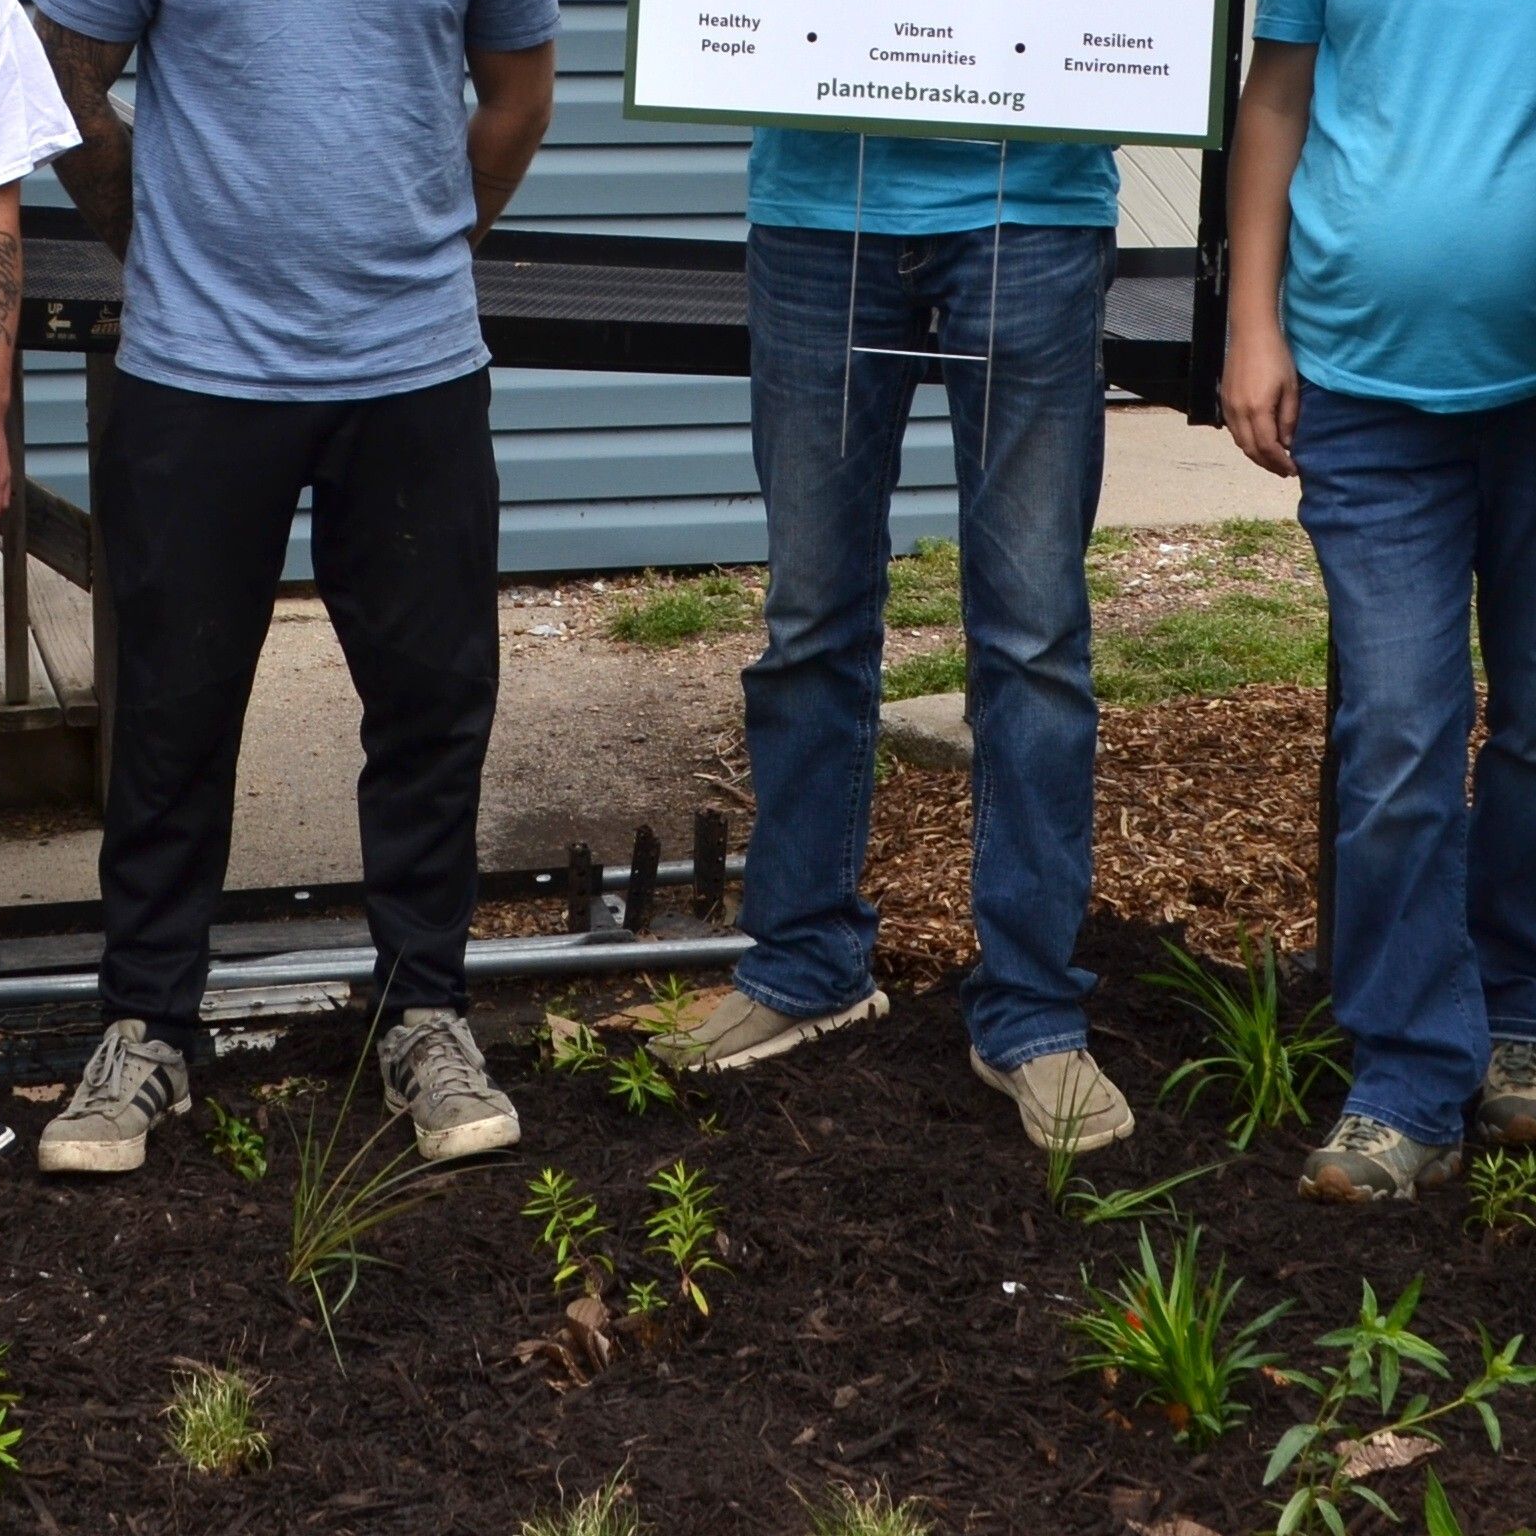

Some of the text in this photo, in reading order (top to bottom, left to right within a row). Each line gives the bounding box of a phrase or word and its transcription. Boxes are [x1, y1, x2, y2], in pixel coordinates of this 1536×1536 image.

[698, 13, 761, 32] Healthy
[894, 22, 954, 39] Vibrant
[700, 38, 756, 56] People
[1082, 32, 1154, 50] Resilient
[869, 47, 977, 66] Communities
[1064, 57, 1170, 76] Environment
[816, 78, 1026, 111] plantnebraska.org
[47, 301, 64, 315] UP
